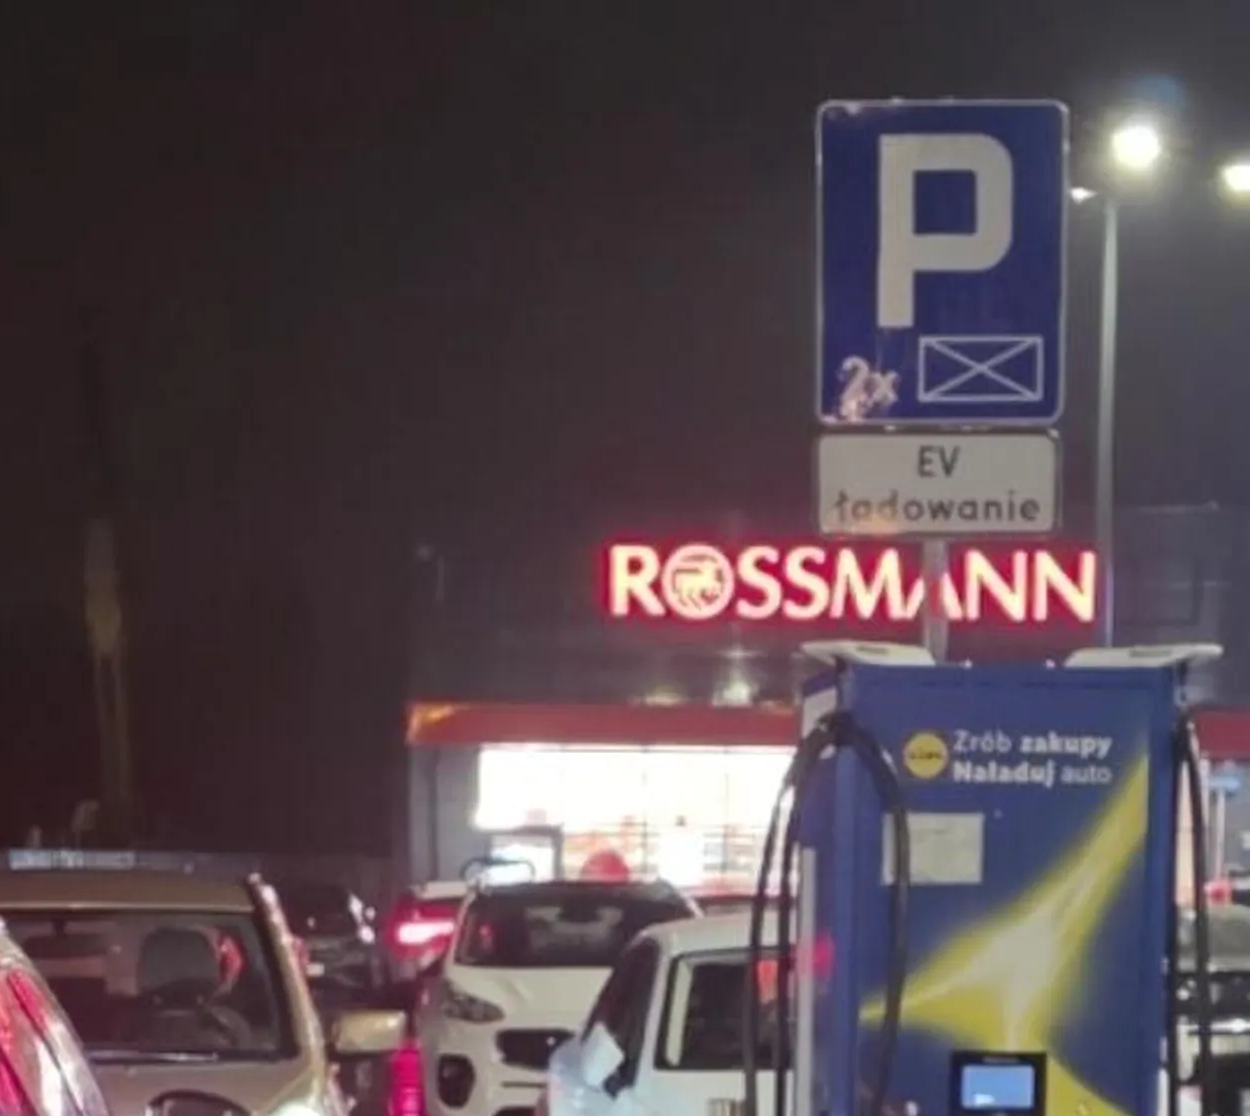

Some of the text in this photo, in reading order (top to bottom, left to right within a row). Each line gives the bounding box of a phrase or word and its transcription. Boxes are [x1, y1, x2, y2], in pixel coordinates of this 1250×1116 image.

[877, 133, 1013, 328] P
[917, 445, 961, 478] EV
[832, 489, 1040, 521] ładowanie
[609, 543, 1097, 623] ROSSMANN
[953, 728, 1112, 760] Zrób zakupy
[1061, 765, 1113, 784] auto
